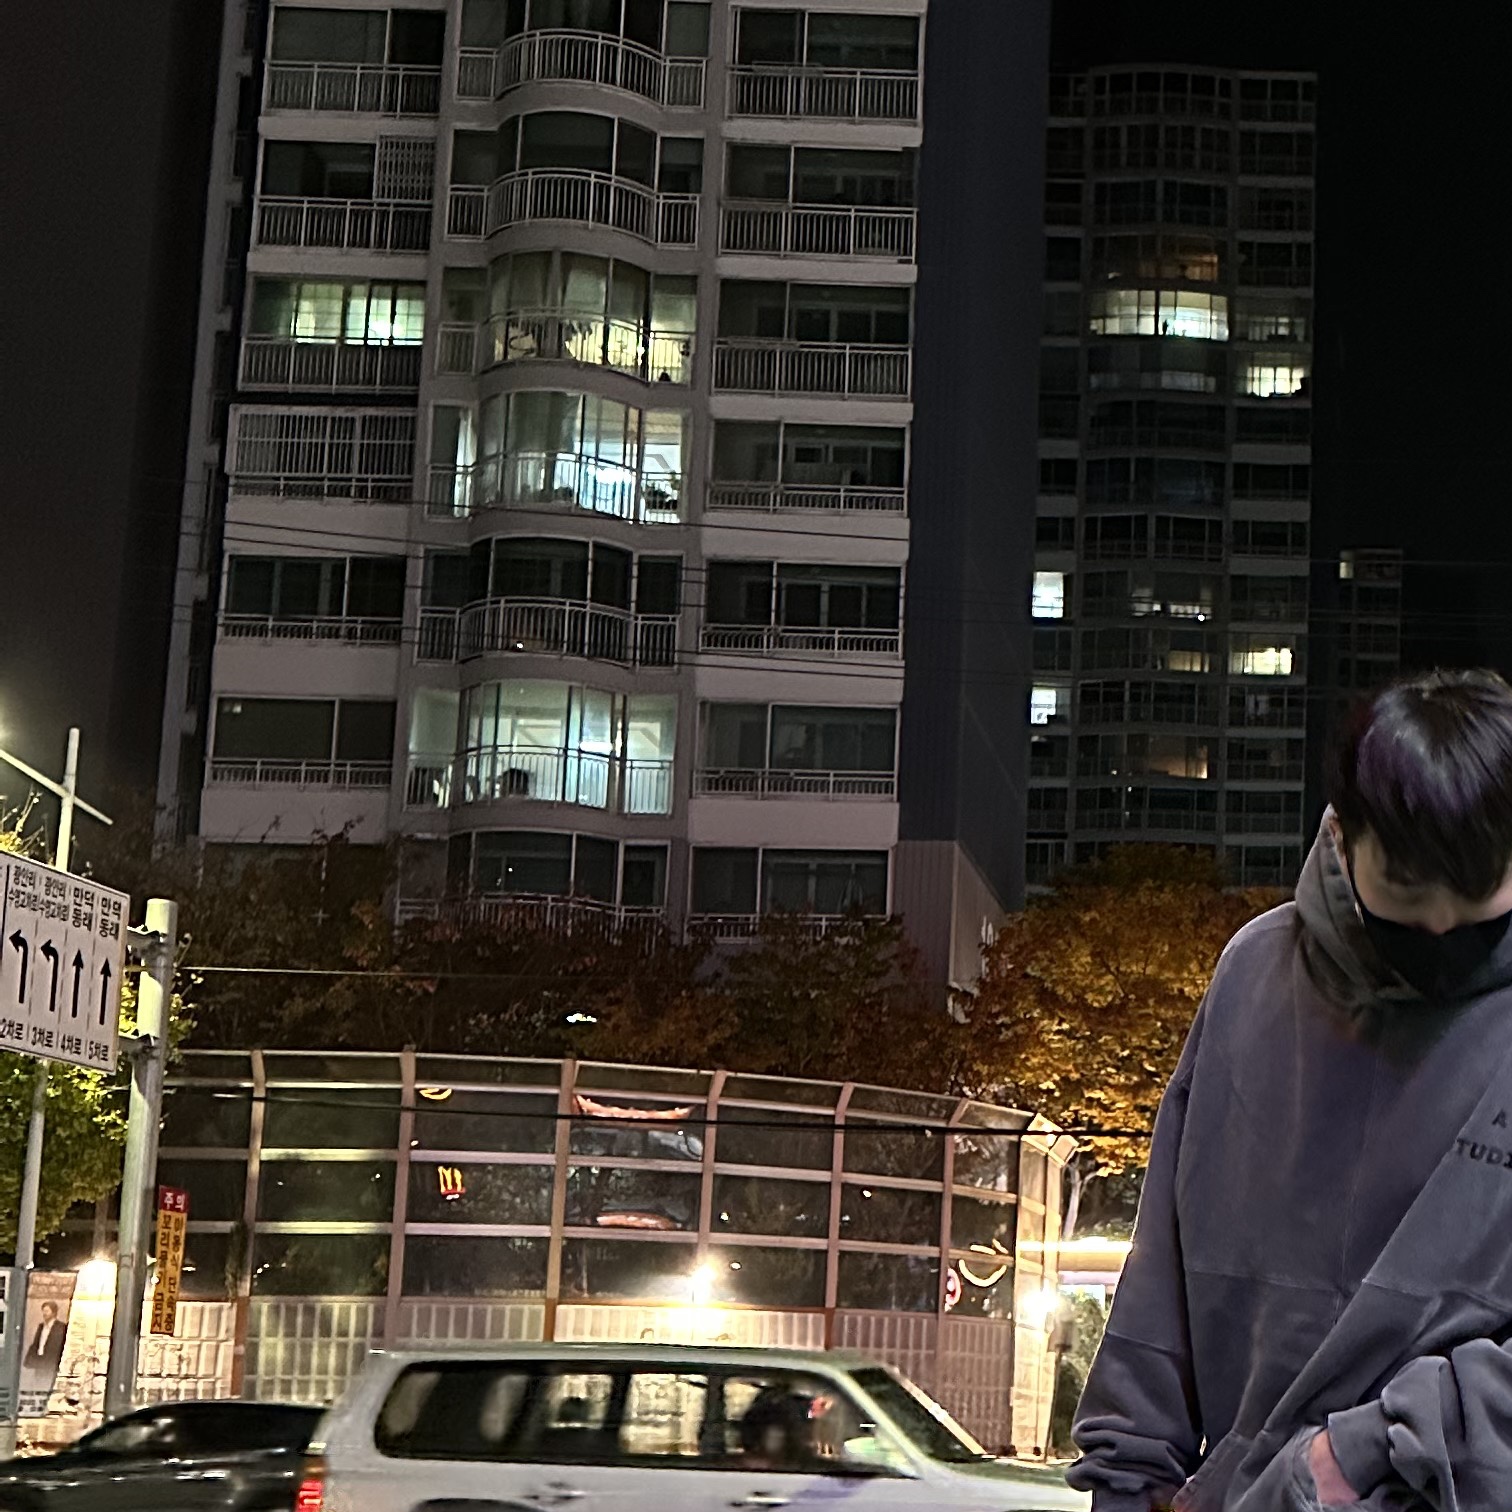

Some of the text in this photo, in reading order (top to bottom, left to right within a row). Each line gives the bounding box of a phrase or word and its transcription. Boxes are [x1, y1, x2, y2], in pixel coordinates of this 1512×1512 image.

[73, 887, 95, 911] 만덕
[101, 897, 122, 921] 만덕
[72, 908, 93, 932] 동래
[99, 918, 120, 941] 동래
[31, 1026, 54, 1048] 3차로
[61, 1034, 82, 1055] 4차로
[88, 1040, 109, 1061] 5차로
[163, 1191, 186, 1212] 주의
